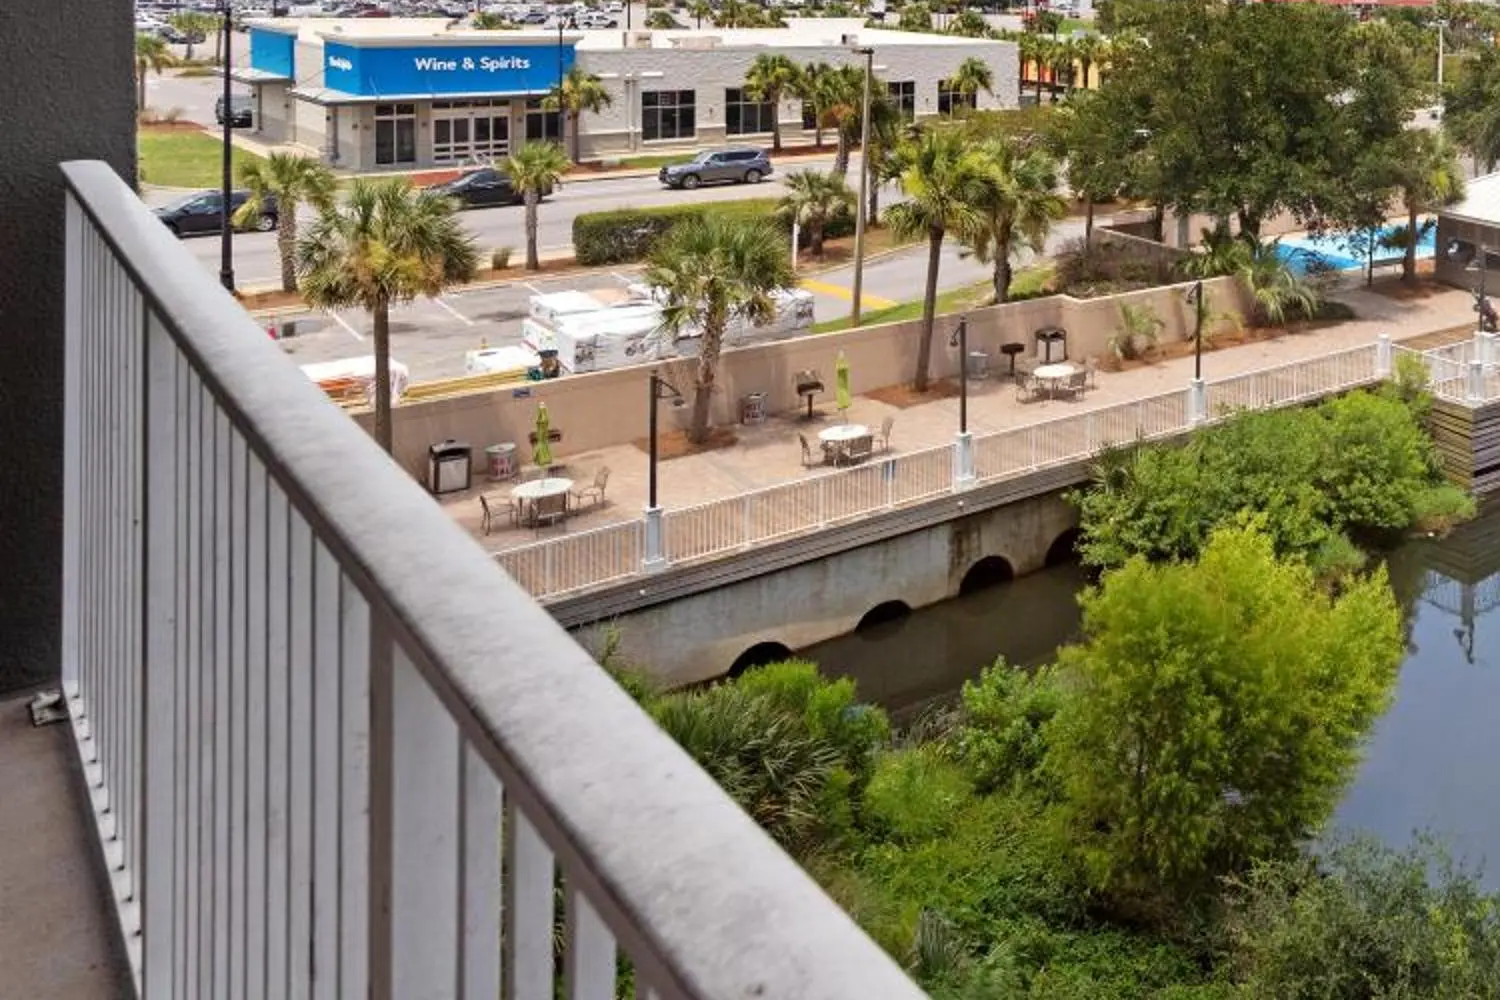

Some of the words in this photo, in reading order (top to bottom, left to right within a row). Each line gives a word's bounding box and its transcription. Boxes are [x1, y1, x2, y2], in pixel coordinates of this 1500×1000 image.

[414, 56, 457, 71] Wine
[461, 56, 475, 70] &
[480, 55, 531, 72] Spirits
